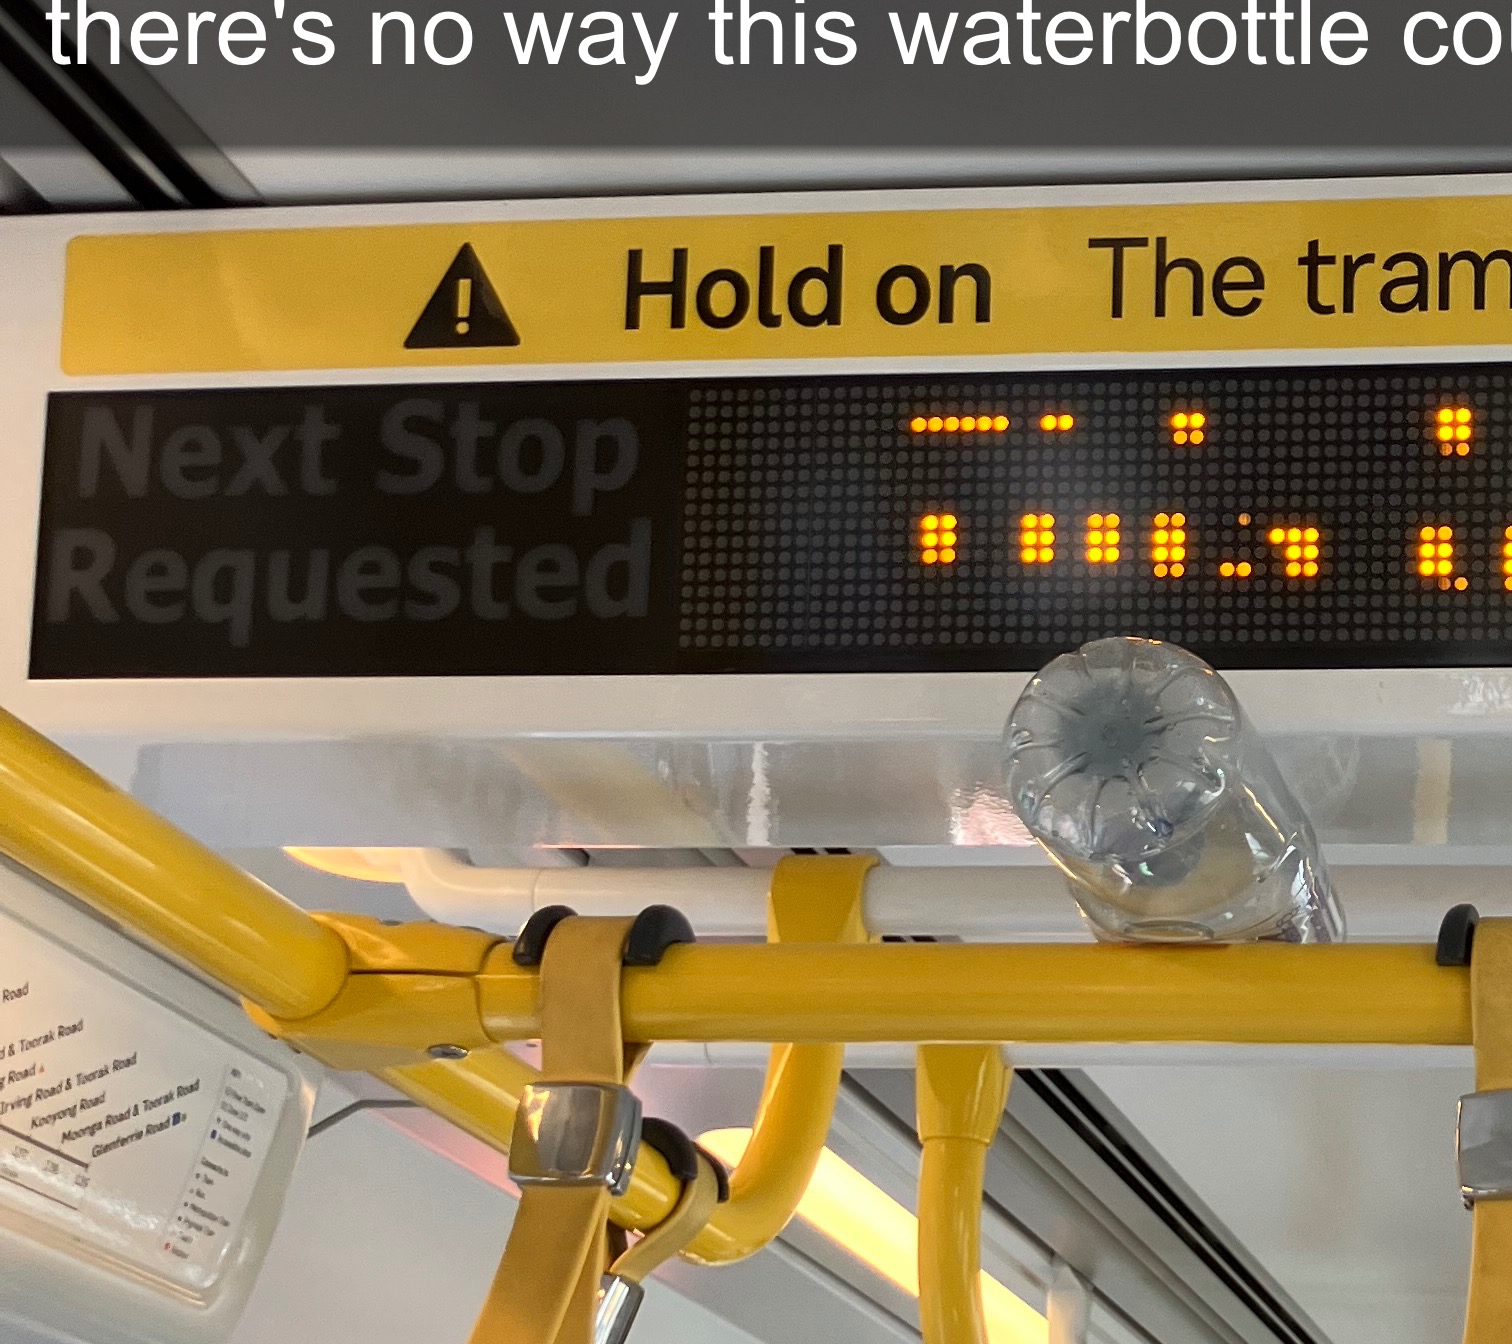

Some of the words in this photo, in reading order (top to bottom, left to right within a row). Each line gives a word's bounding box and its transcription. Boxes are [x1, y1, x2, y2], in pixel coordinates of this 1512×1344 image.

[624, 244, 845, 331] Hold
[875, 259, 992, 326] on
[1088, 236, 1265, 319] The
[79, 403, 340, 501] Next
[375, 397, 641, 517] Stop
[46, 517, 654, 648] Requested
[2, 981, 30, 1003] Road
[20, 1030, 55, 1052] Toorak
[57, 1018, 84, 1039] Road
[8, 1062, 36, 1084] Road
[35, 1079, 63, 1101] Road
[76, 1065, 109, 1087] Toorak
[112, 1052, 137, 1073] Road
[31, 1103, 78, 1130] Kooyong
[79, 1091, 107, 1111] Road
[105, 1108, 131, 1128] Road
[143, 1090, 175, 1112] Toorak
[177, 1078, 201, 1099] Road
[145, 1116, 172, 1136] Road
